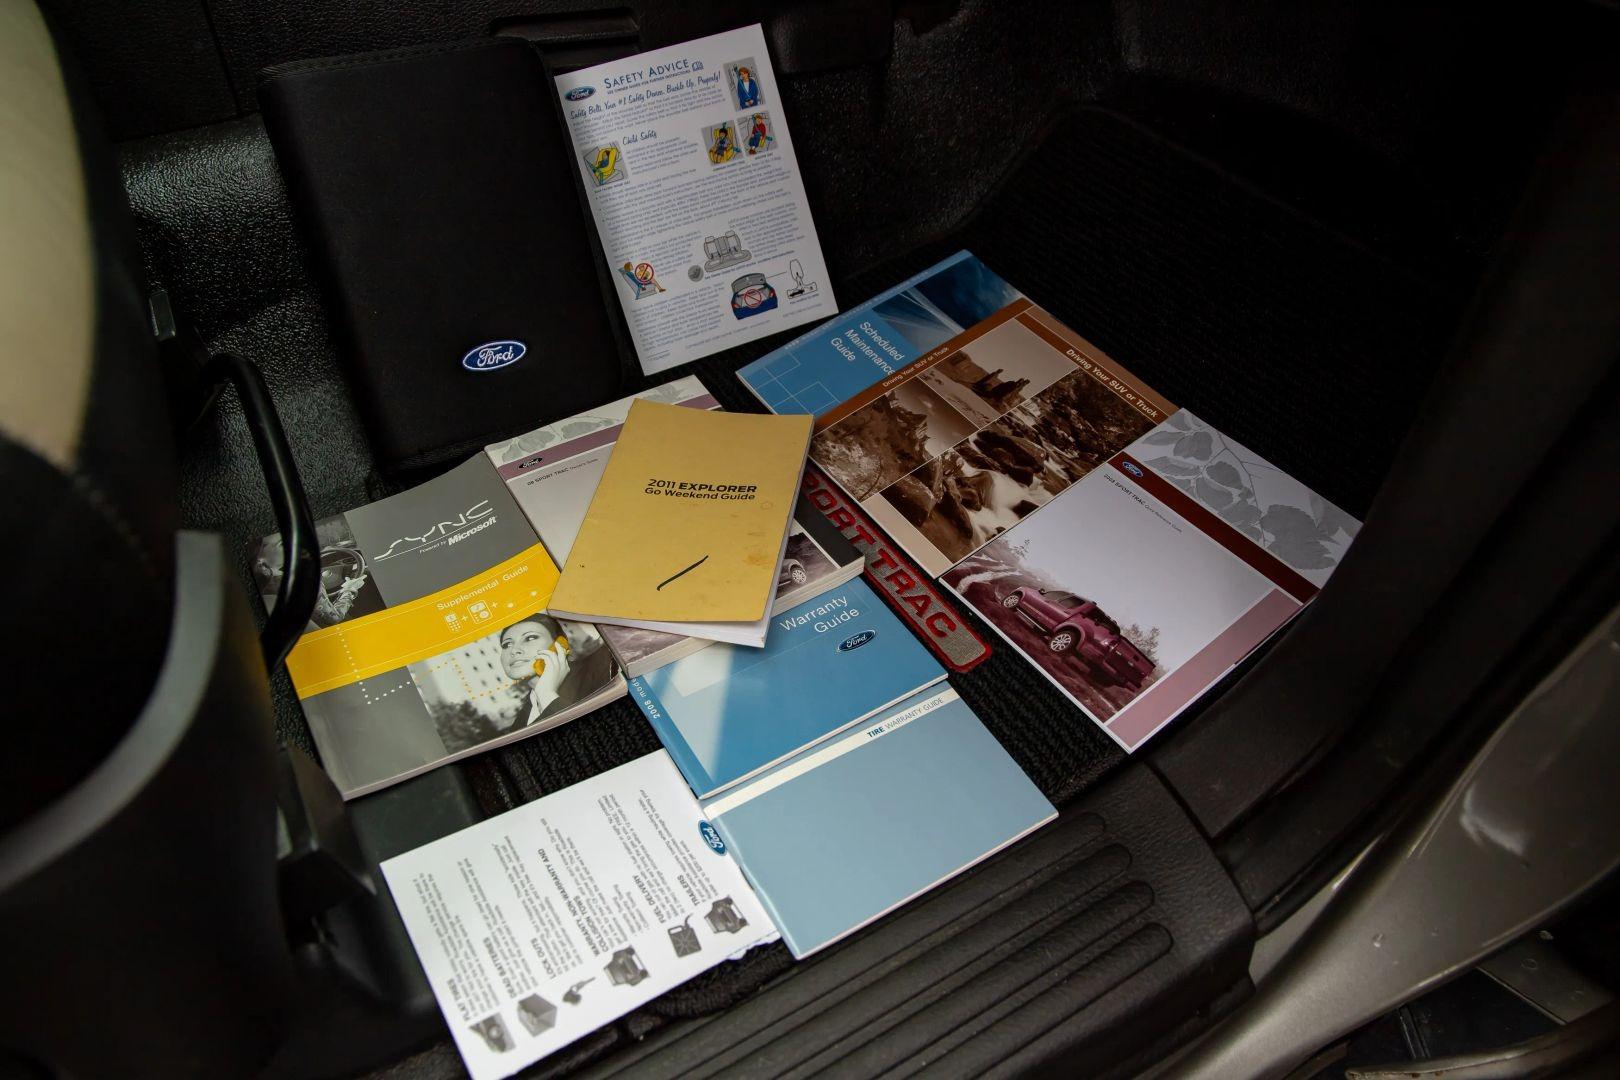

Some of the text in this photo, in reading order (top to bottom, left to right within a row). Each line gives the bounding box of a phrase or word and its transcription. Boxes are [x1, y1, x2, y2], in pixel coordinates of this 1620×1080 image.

[603, 57, 689, 88] SAFETY ADVICE
[568, 107, 586, 120] Safety
[603, 99, 616, 110] Your
[627, 92, 645, 105] Safety
[665, 80, 684, 93] Buckle
[696, 70, 722, 87] Properly!
[621, 133, 638, 146] Child
[638, 127, 657, 142] Safety
[830, 337, 856, 362] Guide
[859, 322, 904, 361] Scheduled
[882, 372, 903, 388] Driving
[901, 365, 915, 376] Your
[932, 345, 949, 357] Truck
[1066, 348, 1158, 418] Driving Your SUV or Truck
[535, 472, 553, 482] SPORT
[554, 466, 569, 475] TRAC
[648, 478, 757, 493] 2011 EXPLORER
[644, 487, 755, 501] Go Weekend Guide
[1114, 481, 1132, 496] SPORT
[1130, 493, 1145, 506] TRAC
[374, 500, 494, 561] SYNC
[419, 542, 440, 554] Powered
[448, 516, 497, 546] Microsoft
[437, 565, 529, 611] Supplemental Guide
[870, 547, 957, 638] TRAC
[779, 595, 849, 633] Warranty
[814, 606, 859, 634] Guide
[643, 698, 661, 719] 2008
[866, 696, 944, 739] TIRE WARRANTY GUIDE
[537, 847, 549, 863] AND
[545, 862, 578, 917] NON-WARRANTY
[633, 873, 666, 923] FUEL DELIVERY
[676, 874, 700, 906] TRAILERS
[572, 895, 609, 953] COLLISION TOWS
[482, 936, 506, 977] BATTERIES
[529, 937, 556, 979] LOCK OUTS
[446, 977, 470, 1021] FLAT TIRES
[501, 976, 517, 998] DEAD
